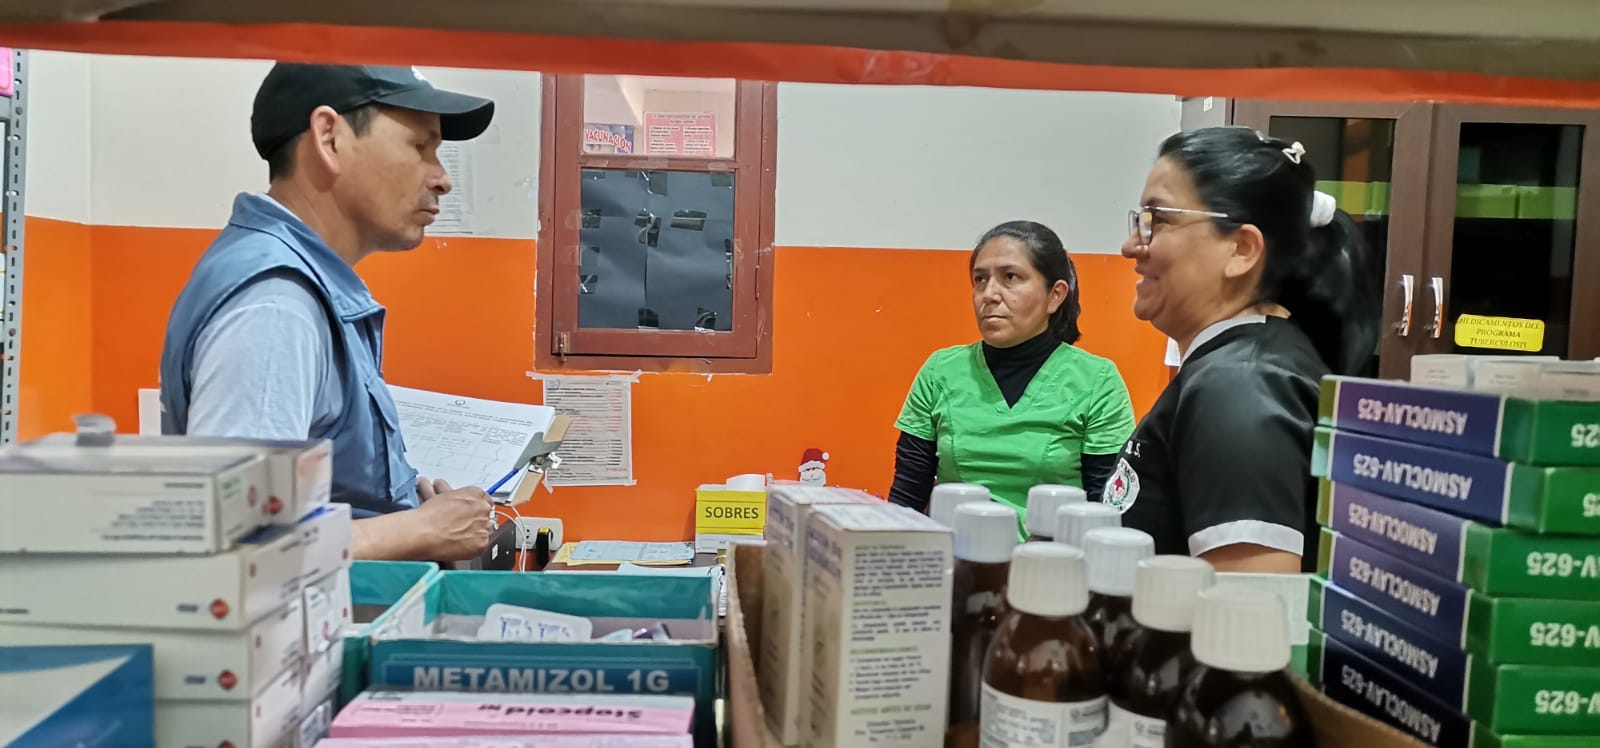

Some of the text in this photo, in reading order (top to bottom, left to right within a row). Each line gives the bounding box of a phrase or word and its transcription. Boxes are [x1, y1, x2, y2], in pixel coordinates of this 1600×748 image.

[584, 128, 632, 154] VACUNACIÓN
[1459, 317, 1523, 329] MEDICAMENTOS
[1476, 328, 1521, 338] PROGRAMA
[1470, 337, 1527, 348] TUBERCULOSIS
[1357, 397, 1468, 436] ASMOCLAV-625
[1571, 423, 1600, 448] 25
[1352, 453, 1473, 501] ASMOCLAV-625
[705, 506, 759, 519] SOBRES
[1348, 502, 1438, 556] ASMOCLAV-625
[1526, 551, 1600, 578] V-625
[1349, 556, 1441, 617] ASMOCLAV-625
[1340, 609, 1439, 679] ASMOCLAV-625
[412, 665, 670, 693] METAMIZOL 1G
[1341, 663, 1442, 744] ASMOCLAV-625
